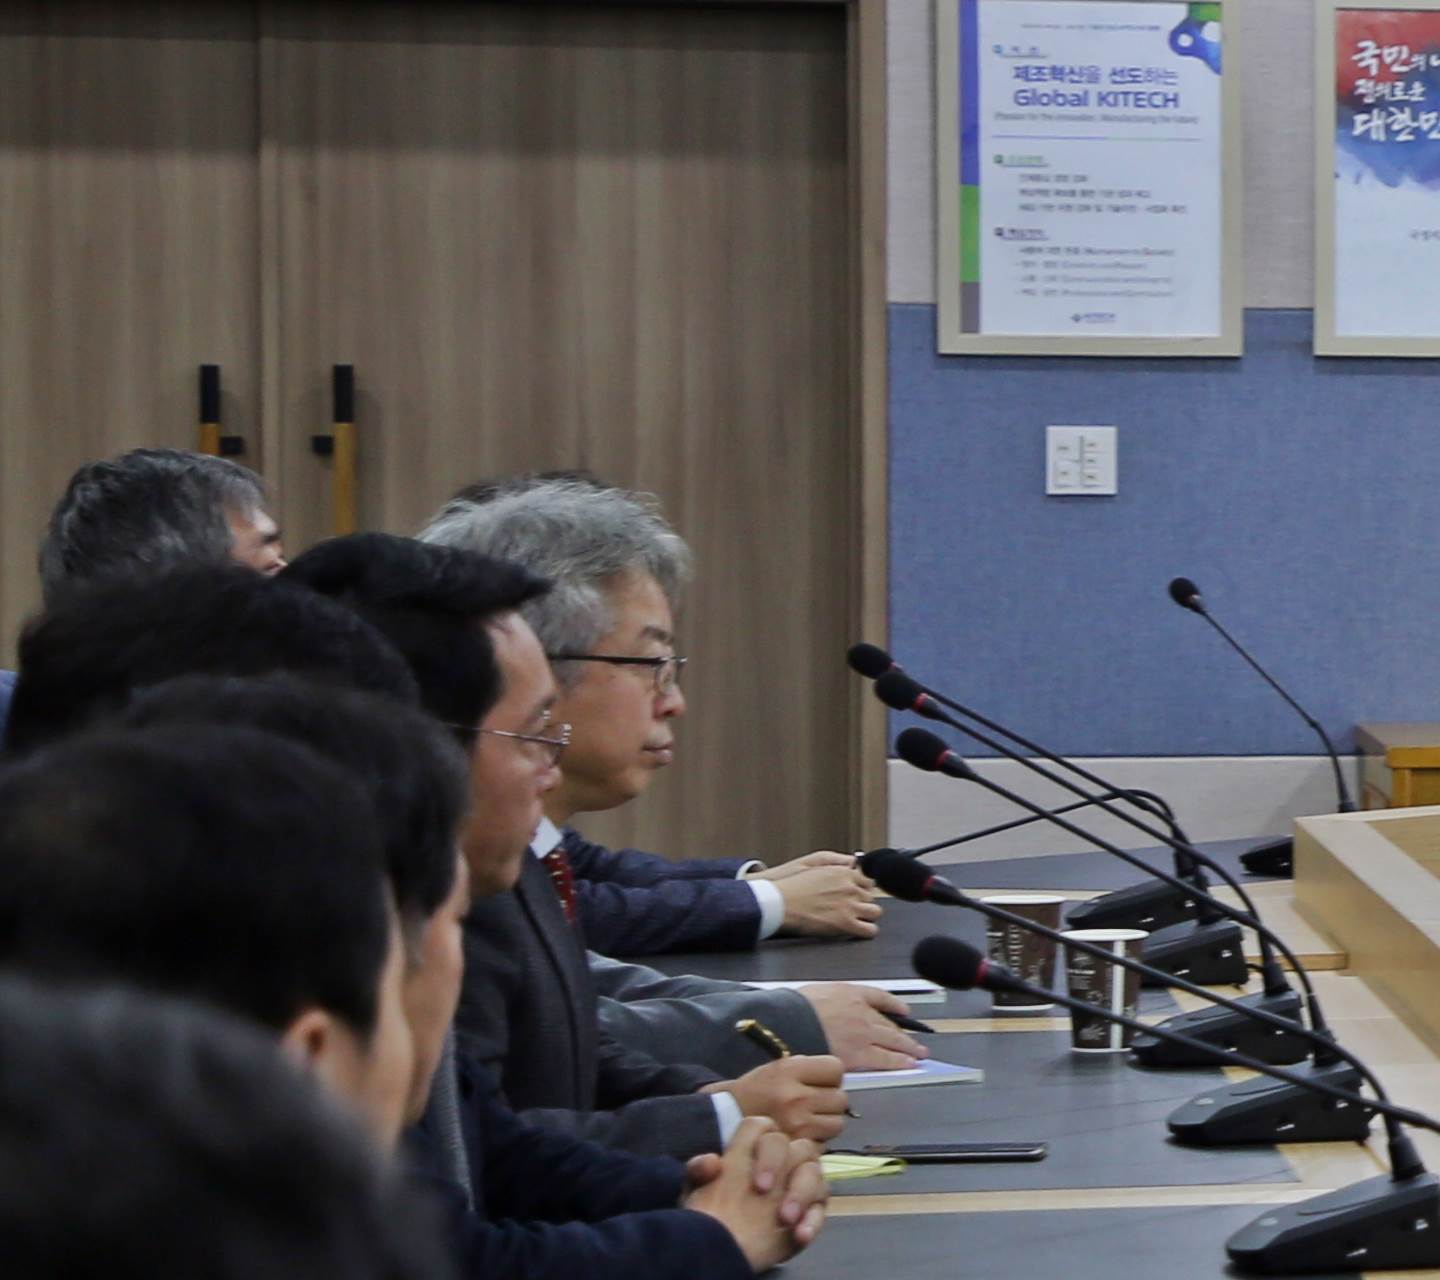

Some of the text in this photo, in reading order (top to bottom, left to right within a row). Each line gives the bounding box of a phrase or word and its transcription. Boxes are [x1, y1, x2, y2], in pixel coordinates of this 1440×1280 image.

[1352, 40, 1427, 76] 국민의
[1013, 65, 1179, 86] 제조혁신을 선도하는
[1013, 89, 1179, 109] Global KITECH
[1354, 78, 1426, 104] 정의로운
